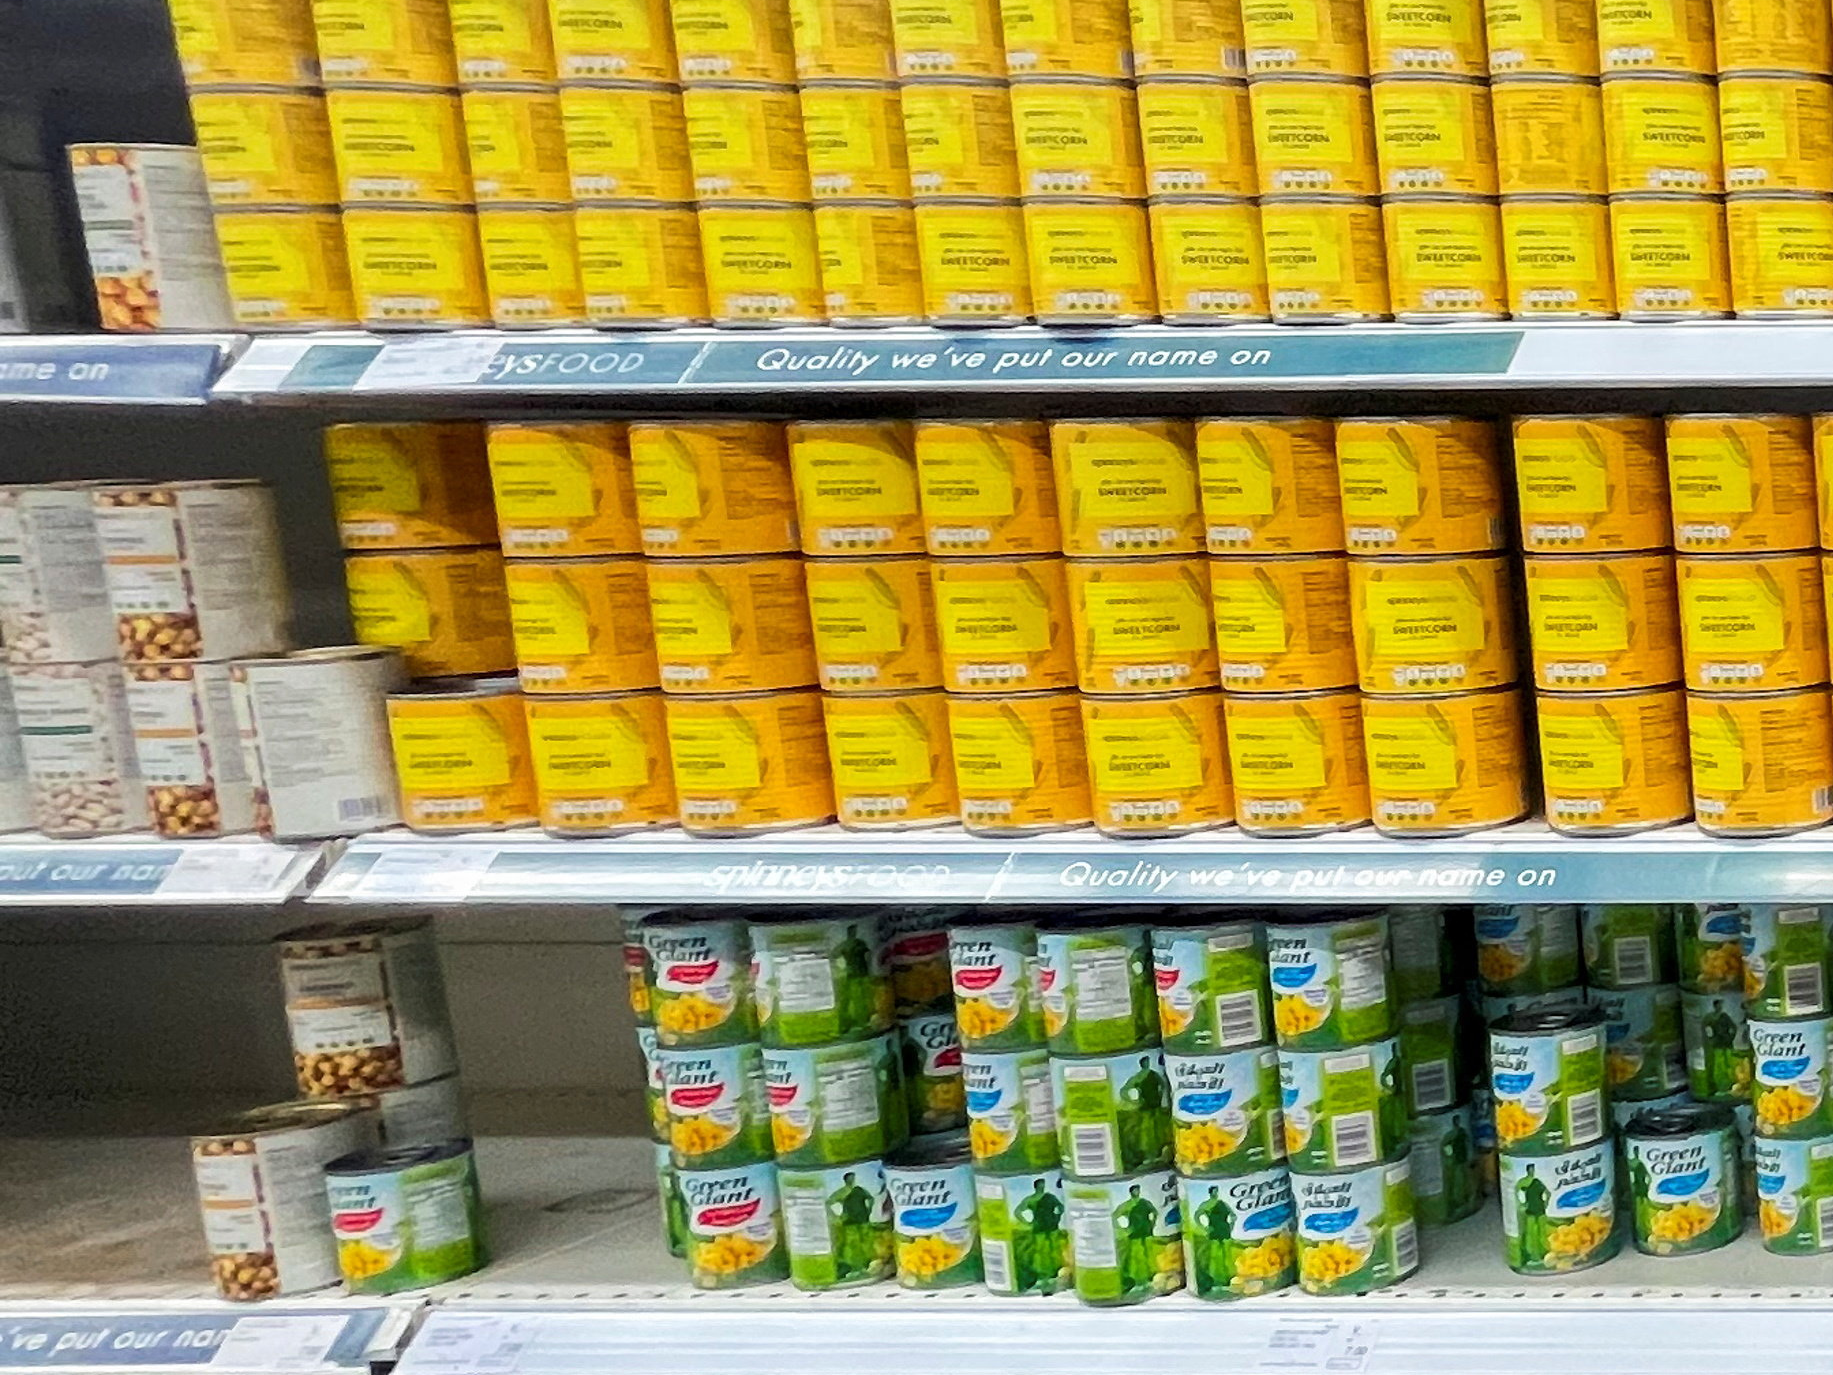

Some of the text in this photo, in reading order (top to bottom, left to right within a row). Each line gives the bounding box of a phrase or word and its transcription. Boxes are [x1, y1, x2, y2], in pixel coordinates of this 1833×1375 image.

[68, 359, 110, 381] on
[756, 346, 1272, 377] Quality we've put our name on
[1059, 859, 1179, 892] Quality
[1190, 862, 1280, 888] we've
[1288, 864, 1345, 894] put
[1417, 866, 1508, 888] name
[1516, 866, 1557, 887] on
[47, 1327, 110, 1359] put
[113, 1328, 165, 1350] our
